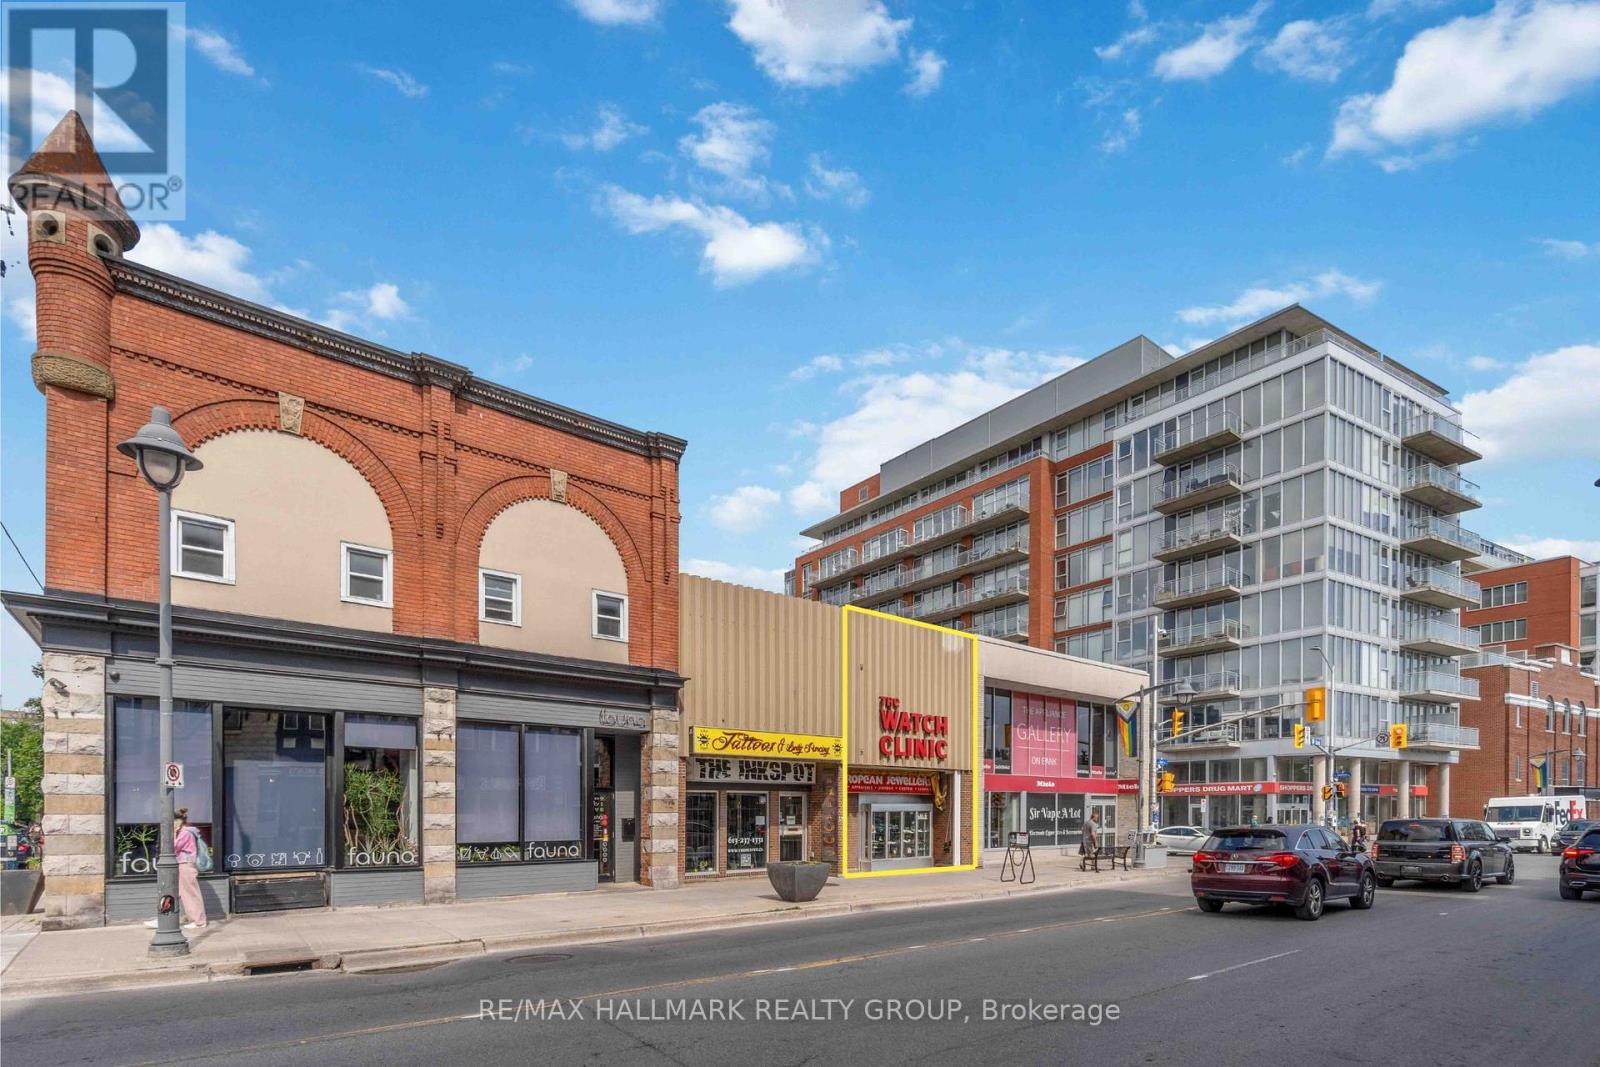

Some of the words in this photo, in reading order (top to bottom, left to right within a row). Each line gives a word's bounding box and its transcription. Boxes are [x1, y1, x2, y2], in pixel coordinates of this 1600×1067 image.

[880, 710, 949, 737] WATCH
[1017, 723, 1071, 744] GALLERY
[712, 731, 777, 751] Tattoos
[879, 735, 948, 761] CLINIC
[695, 758, 731, 779] THE
[738, 760, 815, 782] INKSPOT
[1036, 780, 1056, 788] Miele
[1202, 785, 1227, 793] DRUG
[1227, 784, 1253, 792] MART
[1030, 807, 1040, 820] Sir
[1555, 800, 1584, 825] FedEx
[348, 847, 416, 866] fauna
[527, 842, 580, 859] fauna
